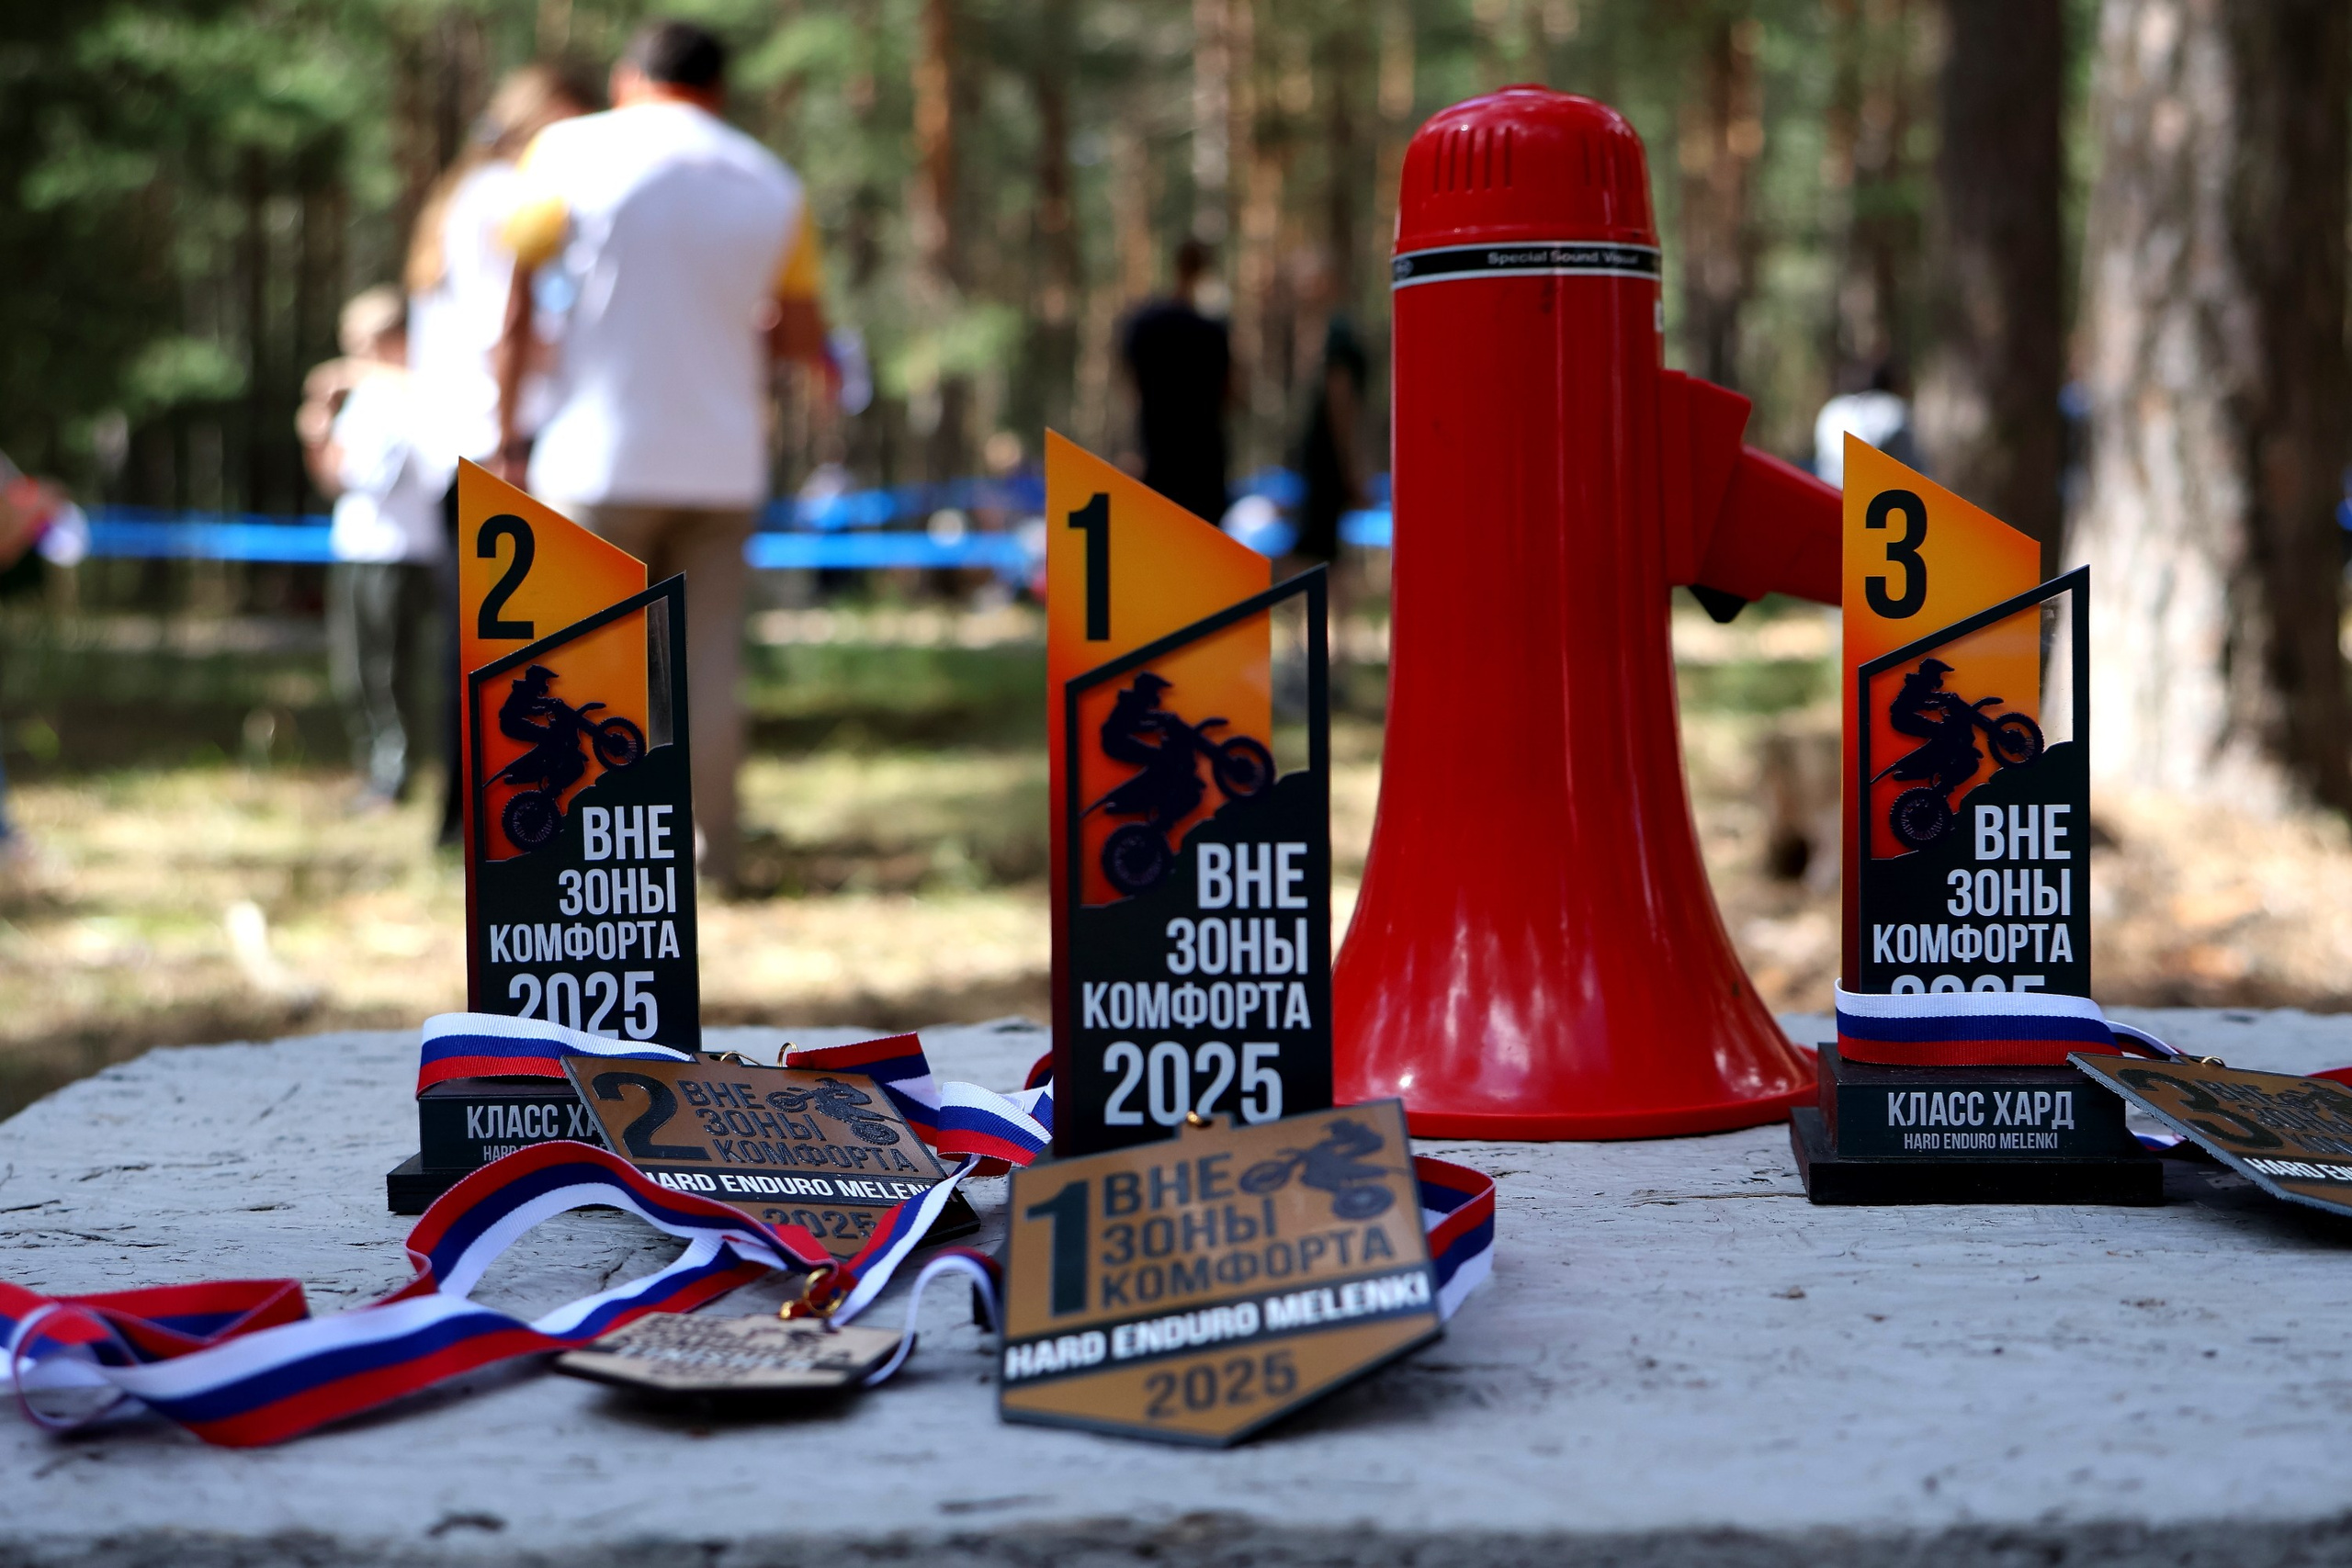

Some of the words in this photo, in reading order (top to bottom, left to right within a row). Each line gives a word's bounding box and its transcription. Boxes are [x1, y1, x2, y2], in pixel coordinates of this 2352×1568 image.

[1487, 251, 1547, 265] Special
[1550, 250, 1599, 264] Sound
[477, 514, 535, 639] 2
[1069, 492, 1110, 640] 1
[1865, 490, 1928, 619] 3
[582, 805, 674, 861] ВНЕ
[1974, 804, 2071, 860] ВНЕ
[558, 867, 676, 916] ЗОНЫ
[1197, 842, 1308, 909] ВНЕ
[1947, 868, 2071, 917] ЗОНЫ
[490, 920, 680, 963] КОМФОРТА
[1166, 917, 1308, 975] ЗОНЫ
[1872, 923, 2074, 964] КОМФОРТА
[508, 971, 658, 1040] 2025
[1082, 981, 1312, 1030] КОМФОРТА
[676, 1079, 764, 1111] ВНЕ
[1103, 1041, 1283, 1127] 2025
[1888, 1091, 1984, 1126] КЛАСС
[1993, 1090, 2075, 1130] ХАРД
[467, 1104, 559, 1139] КЛАСС
[592, 1071, 712, 1160] 2
[695, 1107, 827, 1142] ЗОНЫ
[1904, 1134, 1940, 1149] HARD
[1944, 1134, 1996, 1149] ENDURO
[1999, 1133, 2058, 1149] MELENKI
[712, 1138, 920, 1172] КОМФОРТА
[2242, 1156, 2326, 1179] HARD
[718, 1174, 834, 1196] ENDURO
[1105, 1152, 1233, 1218] ВНЕ
[1023, 1179, 1092, 1317] 1
[1102, 1197, 1276, 1267] ЗОНЫ
[1102, 1226, 1396, 1310] КОМФОРТА
[1005, 1332, 1107, 1377] HARD
[1111, 1300, 1261, 1359] ENDURO
[1264, 1270, 1432, 1328] MELENKI
[1143, 1348, 1298, 1418] 2025
